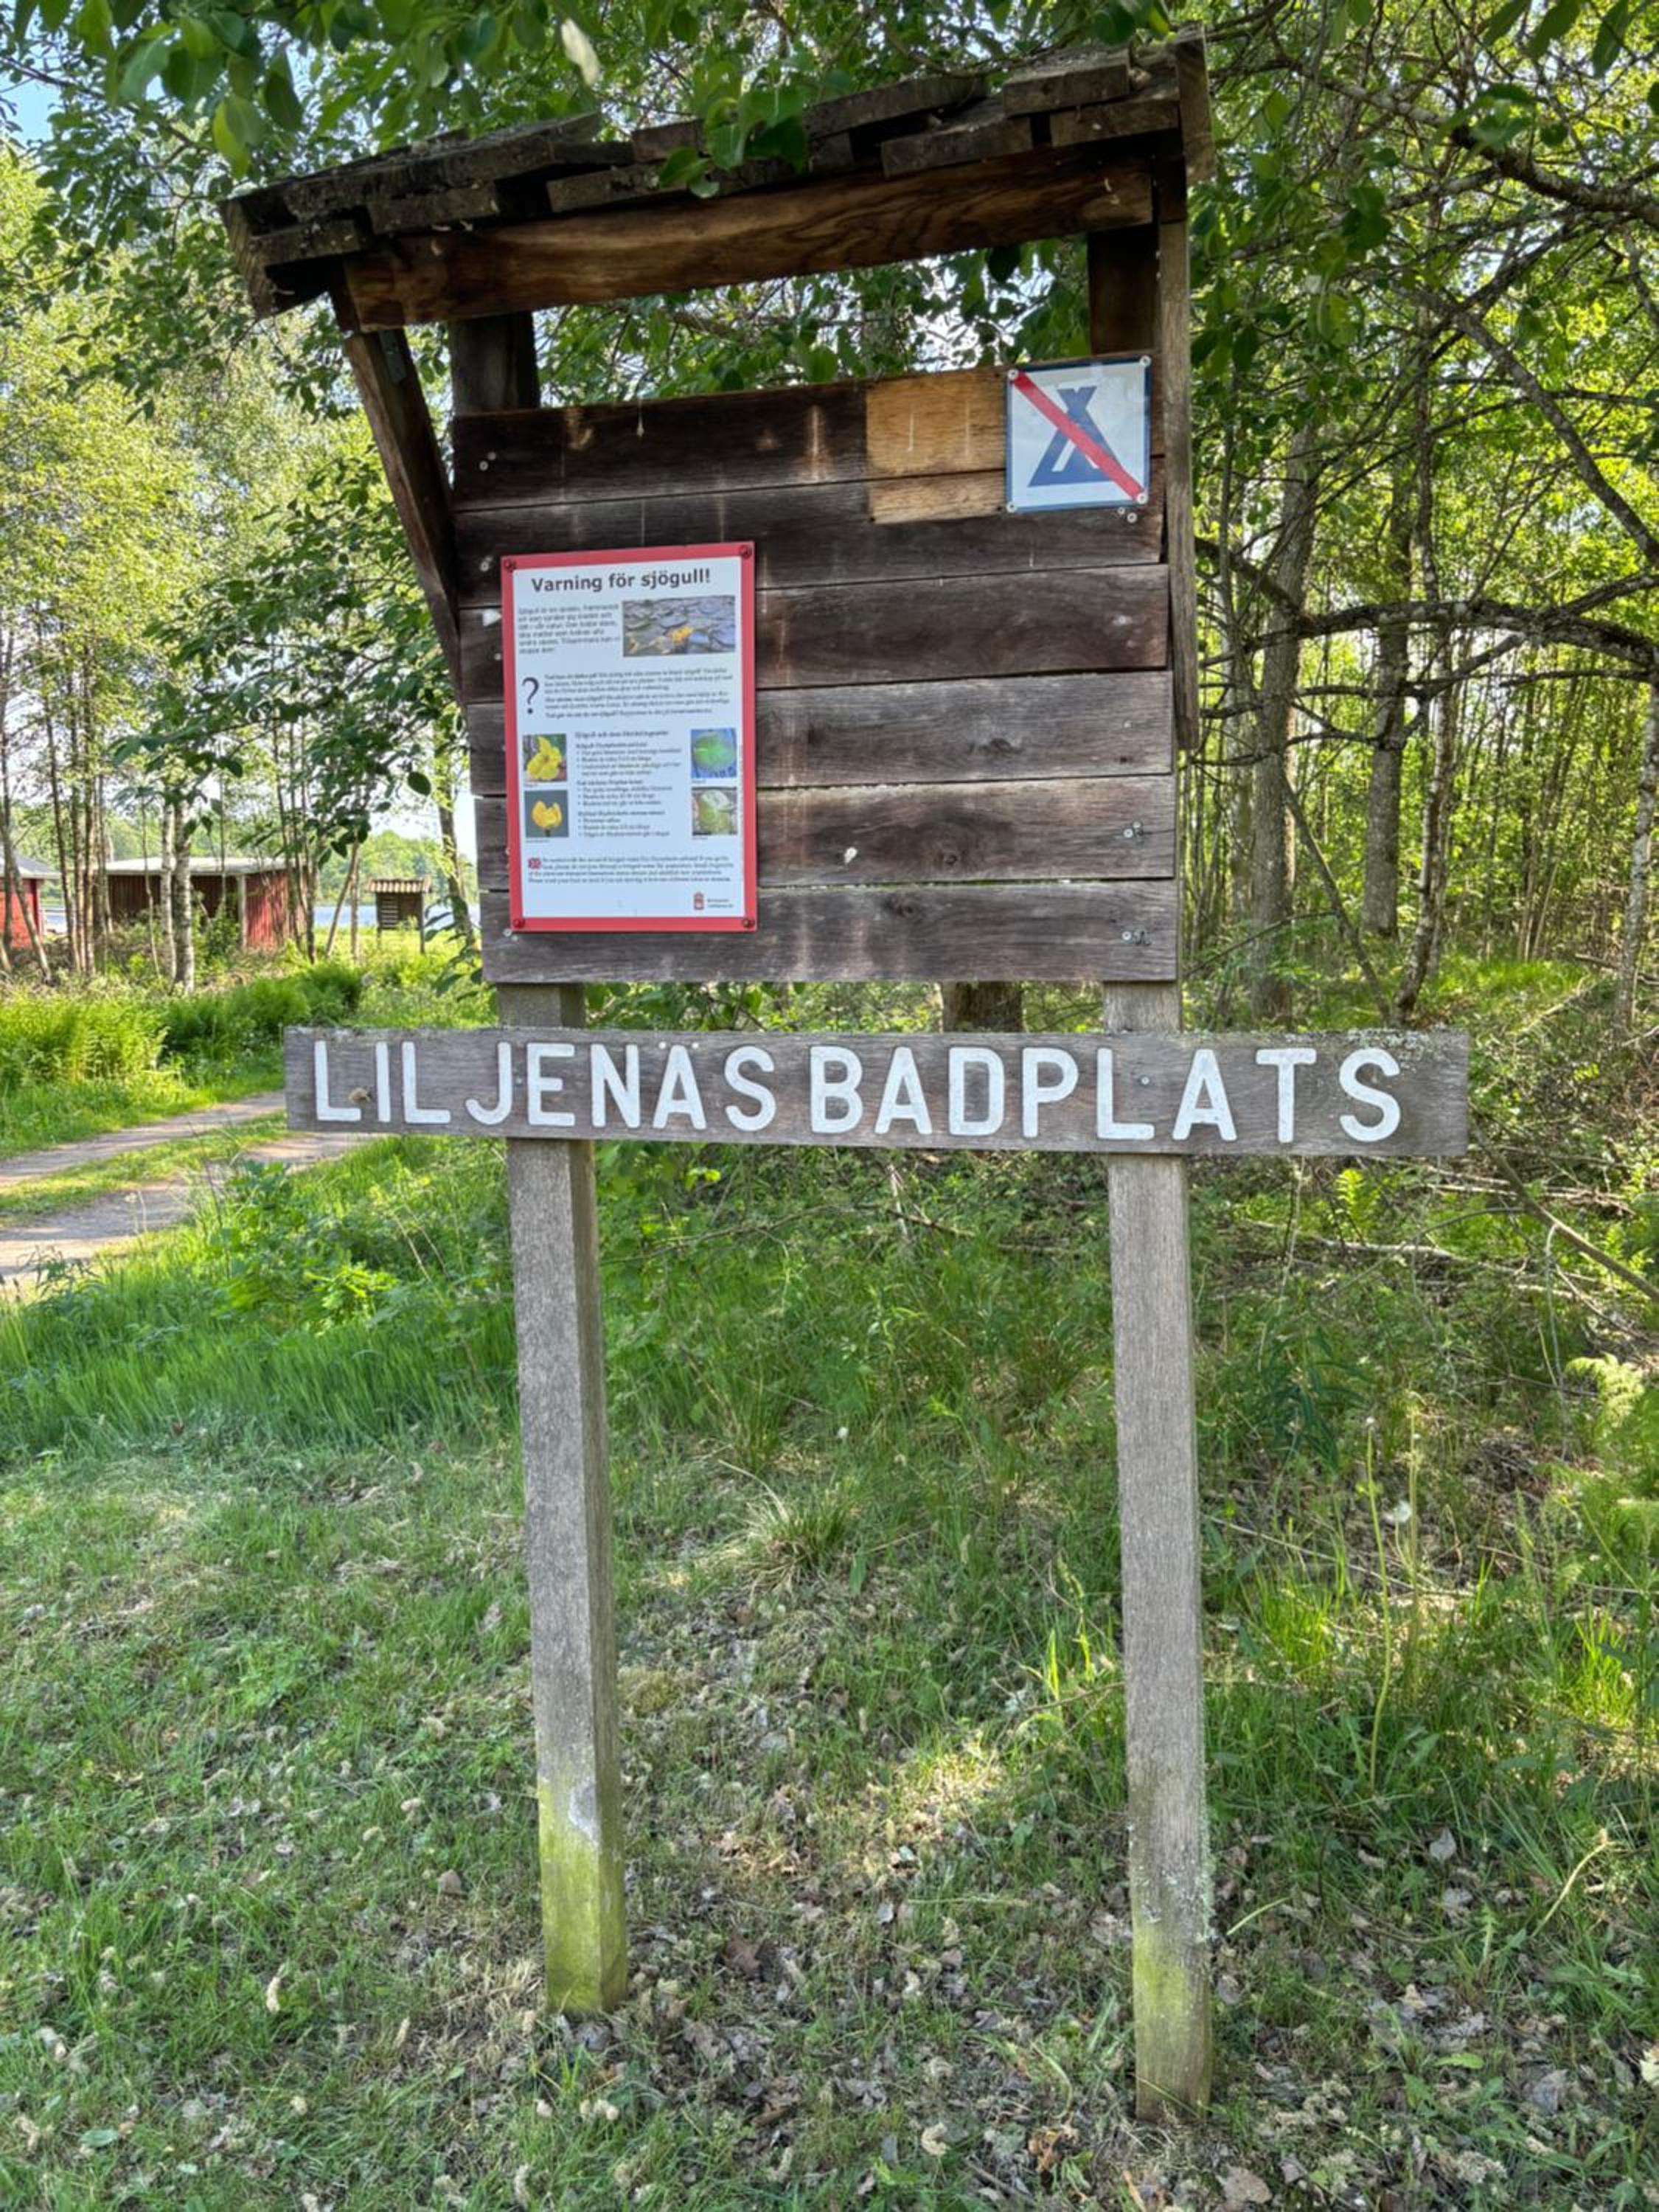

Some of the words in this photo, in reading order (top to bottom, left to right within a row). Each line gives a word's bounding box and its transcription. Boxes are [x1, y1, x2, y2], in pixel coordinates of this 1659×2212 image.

[532, 574, 602, 593] Varning
[609, 572, 636, 588] för
[641, 568, 710, 590] sjögull!
[522, 676, 540, 714] ?
[313, 1040, 778, 1132] LILJENÄS
[810, 1046, 1402, 1143] BADPLATS
